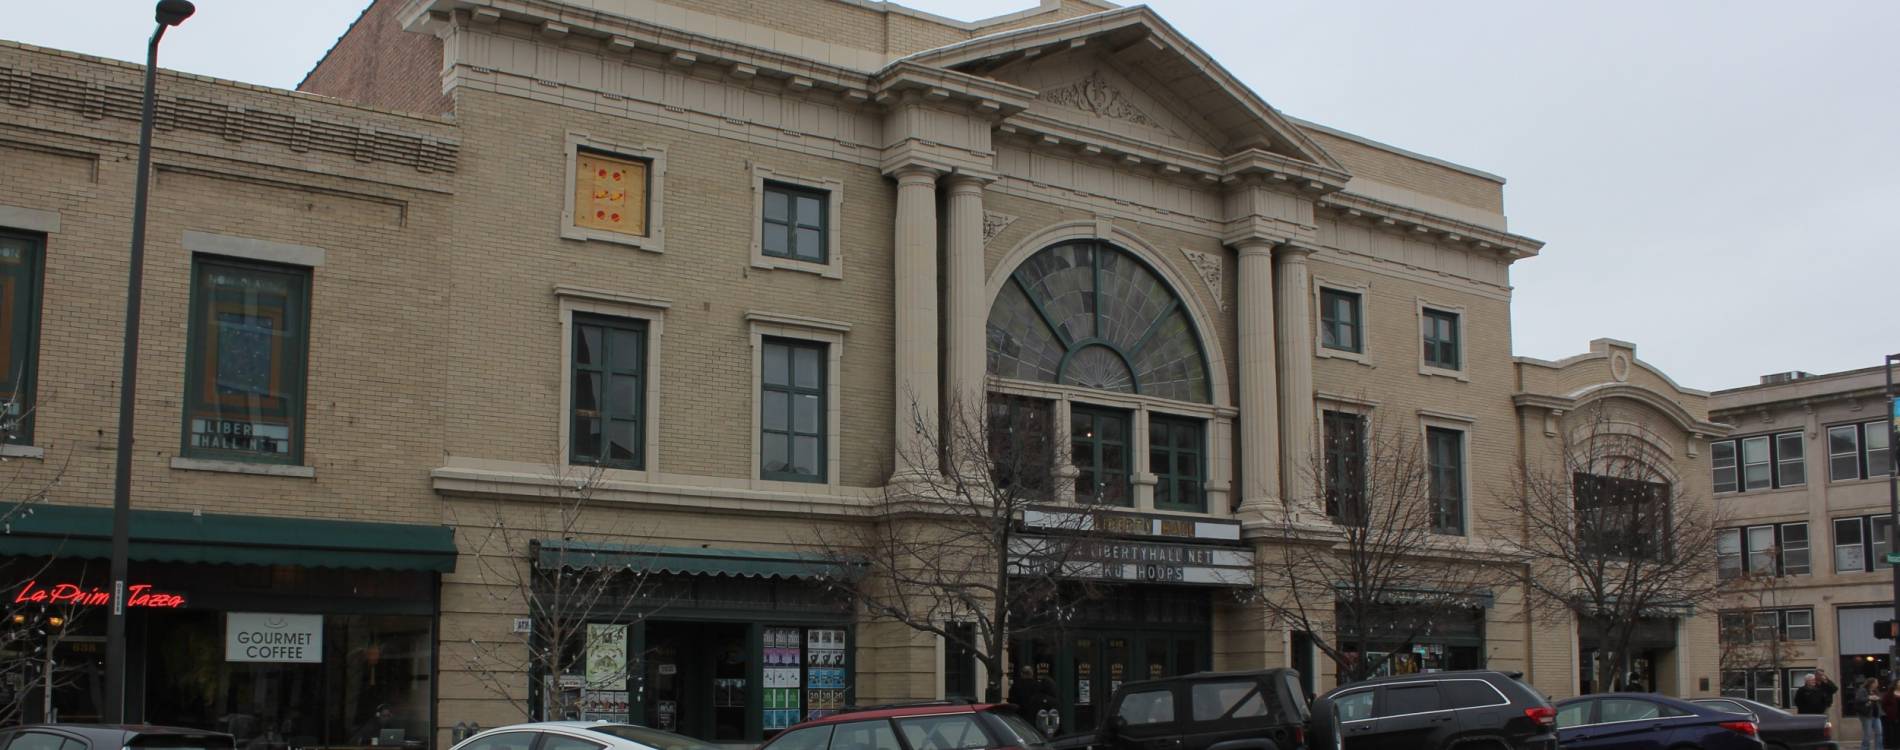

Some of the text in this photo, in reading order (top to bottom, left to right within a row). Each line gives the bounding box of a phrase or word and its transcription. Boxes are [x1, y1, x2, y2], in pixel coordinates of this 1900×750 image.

[201, 435, 239, 449] HALL
[1187, 550, 1213, 564] NET
[1104, 563, 1183, 580] KU HOOPS
[15, 580, 49, 604] La
[49, 583, 110, 606] Prim
[127, 584, 186, 607] Tazza
[238, 632, 312, 645] GOURMET
[247, 646, 303, 659] COFFEE
